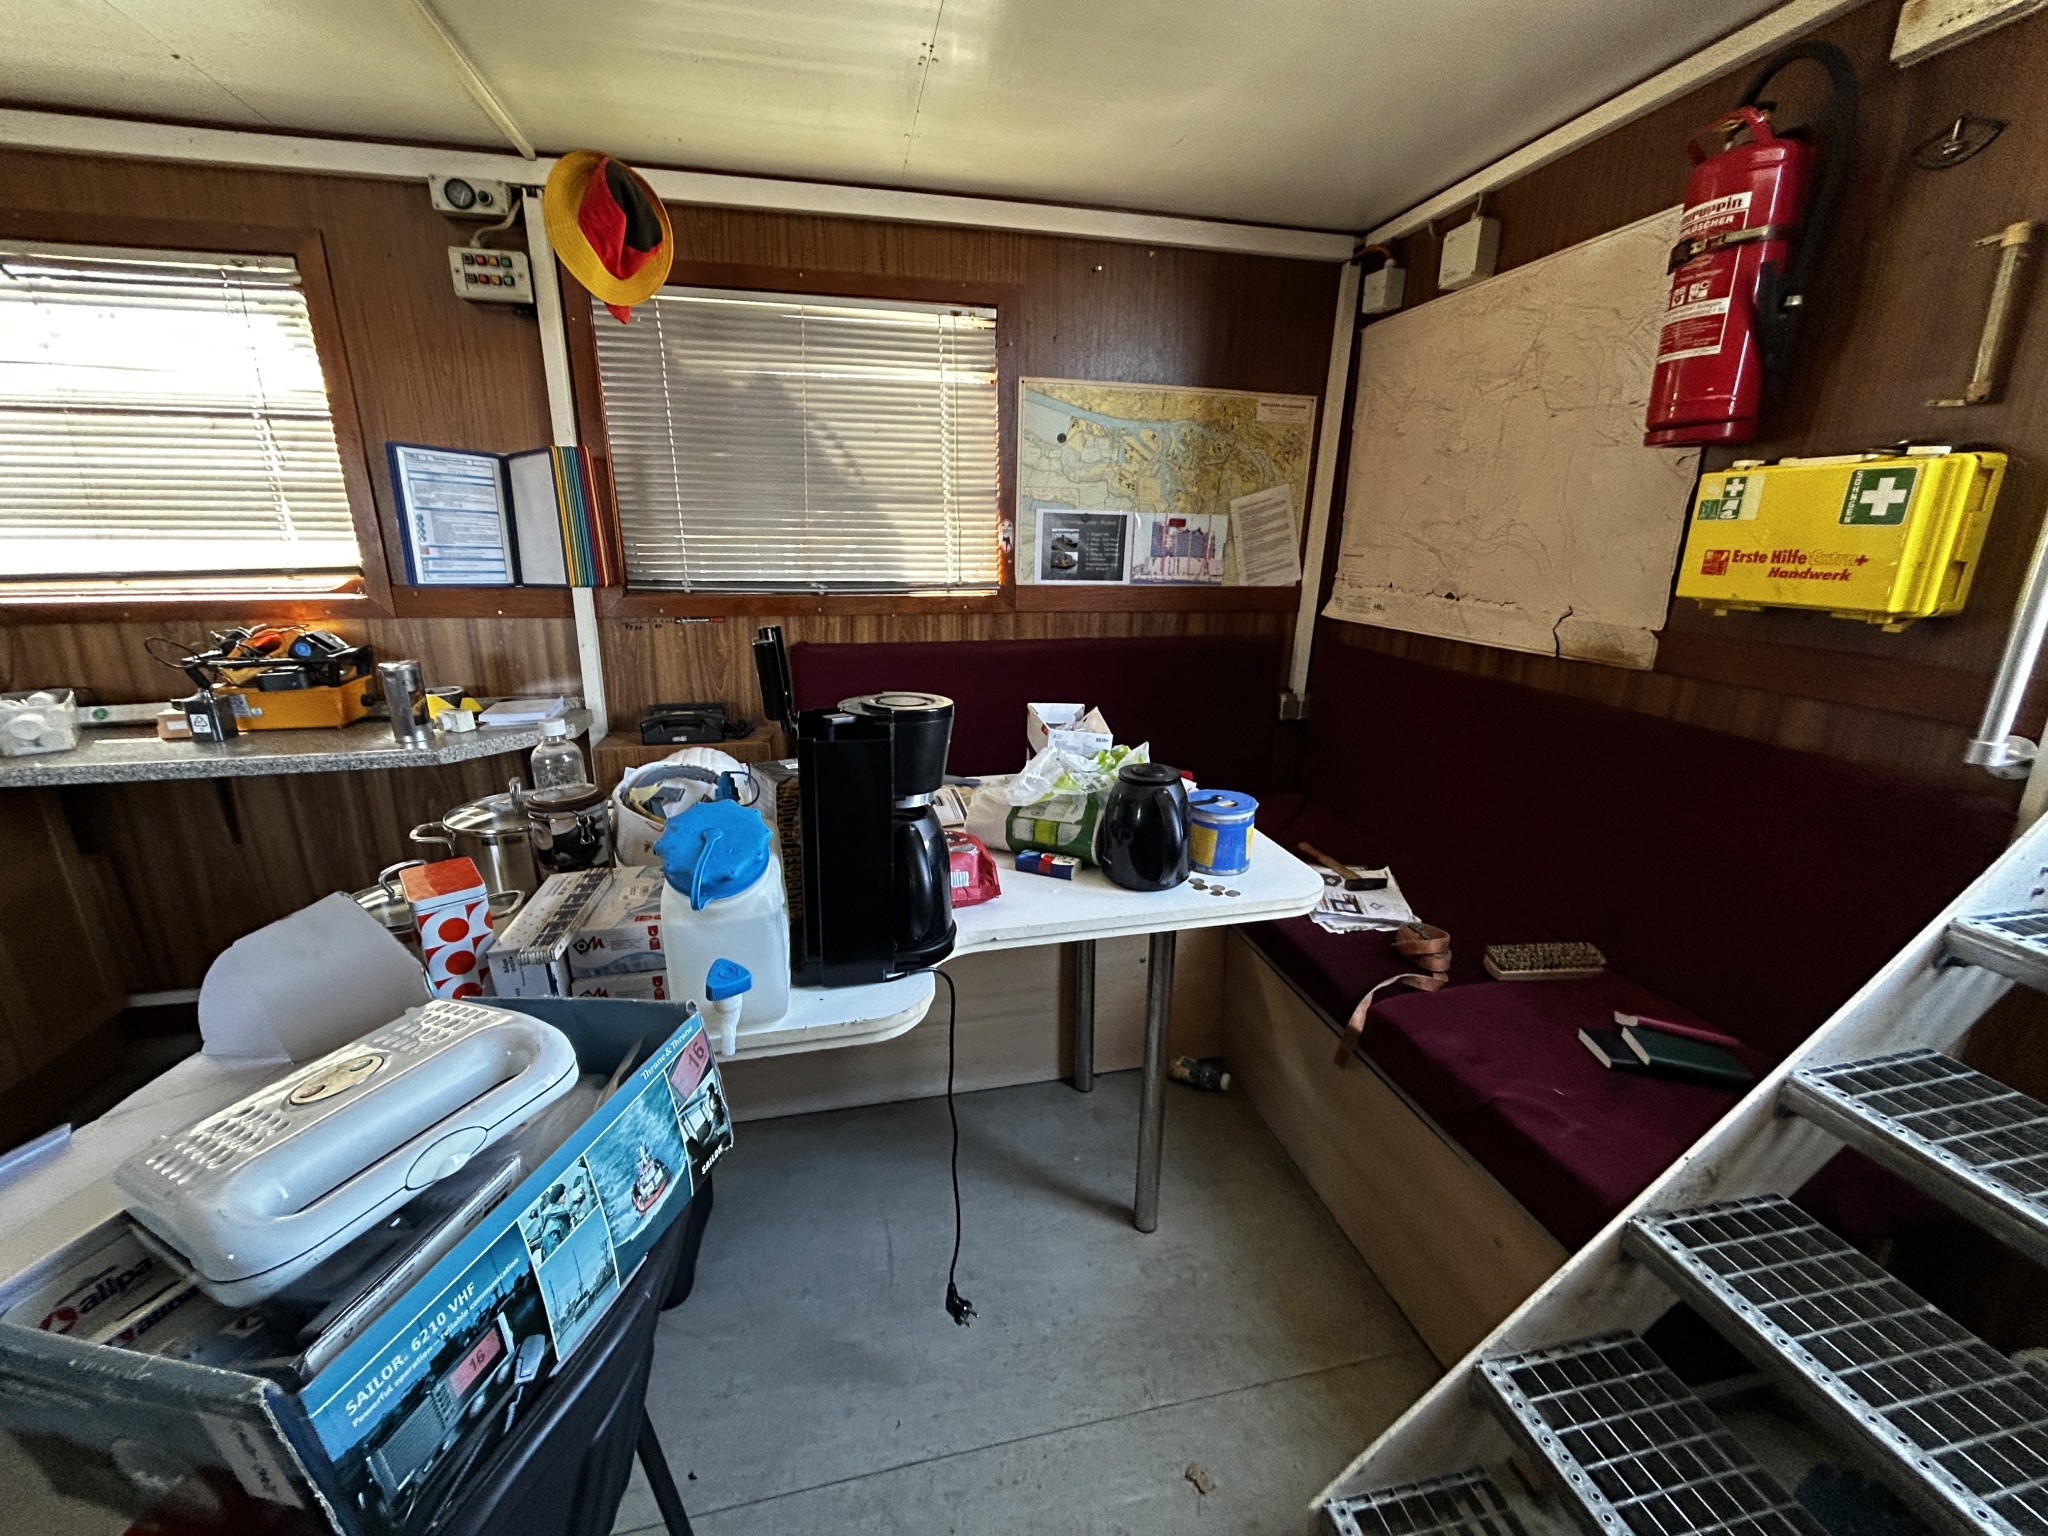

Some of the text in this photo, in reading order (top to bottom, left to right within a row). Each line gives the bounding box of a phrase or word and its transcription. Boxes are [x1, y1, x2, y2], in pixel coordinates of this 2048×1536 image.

[1731, 549, 1768, 563] Erste
[1770, 549, 1807, 565] Hilfe
[1767, 567, 1852, 581] Handwerk
[641, 1025, 693, 1081] Thrane & Thrane
[688, 1042, 705, 1069] 16
[701, 1143, 723, 1175] SAILOR
[410, 1312, 447, 1352] 6210
[447, 1281, 476, 1313] VHF
[352, 1386, 394, 1428] Powerful
[393, 1345, 434, 1387] operation
[440, 1309, 470, 1341] reliable
[469, 1257, 520, 1310] communication
[469, 1350, 485, 1371] 16
